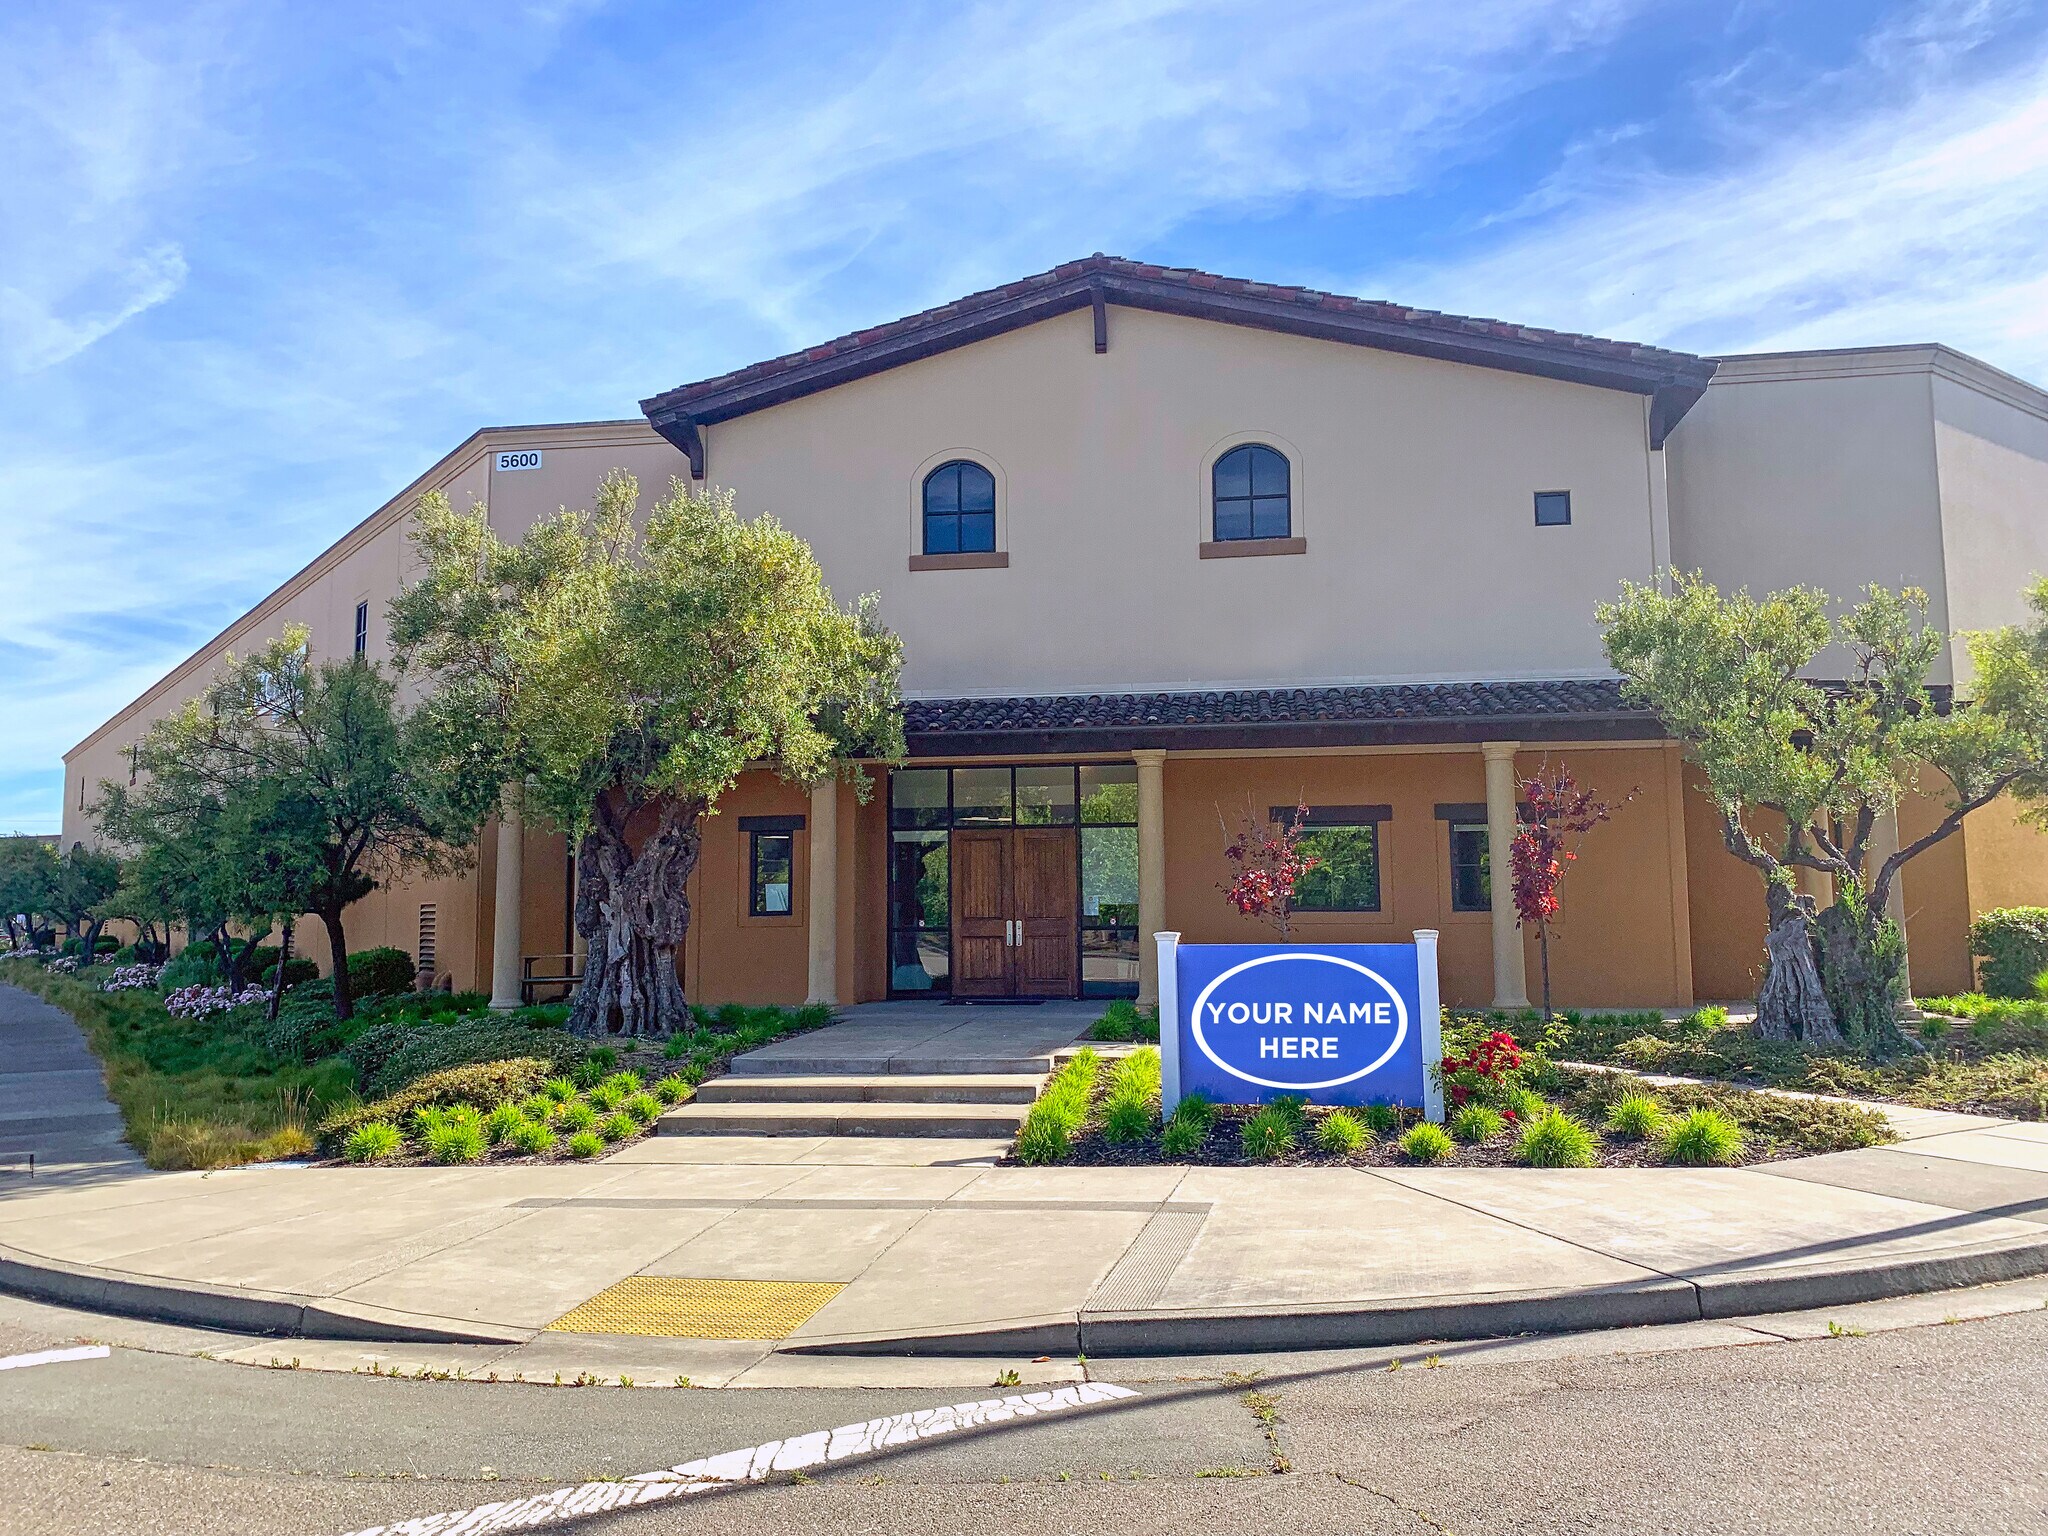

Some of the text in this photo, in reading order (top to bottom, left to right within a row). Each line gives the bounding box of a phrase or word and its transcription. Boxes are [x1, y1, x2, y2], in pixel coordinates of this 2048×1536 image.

[500, 453, 538, 468] 5600
[1207, 1002, 1391, 1025] YOUR NAME
[1260, 1037, 1339, 1059] HERE
